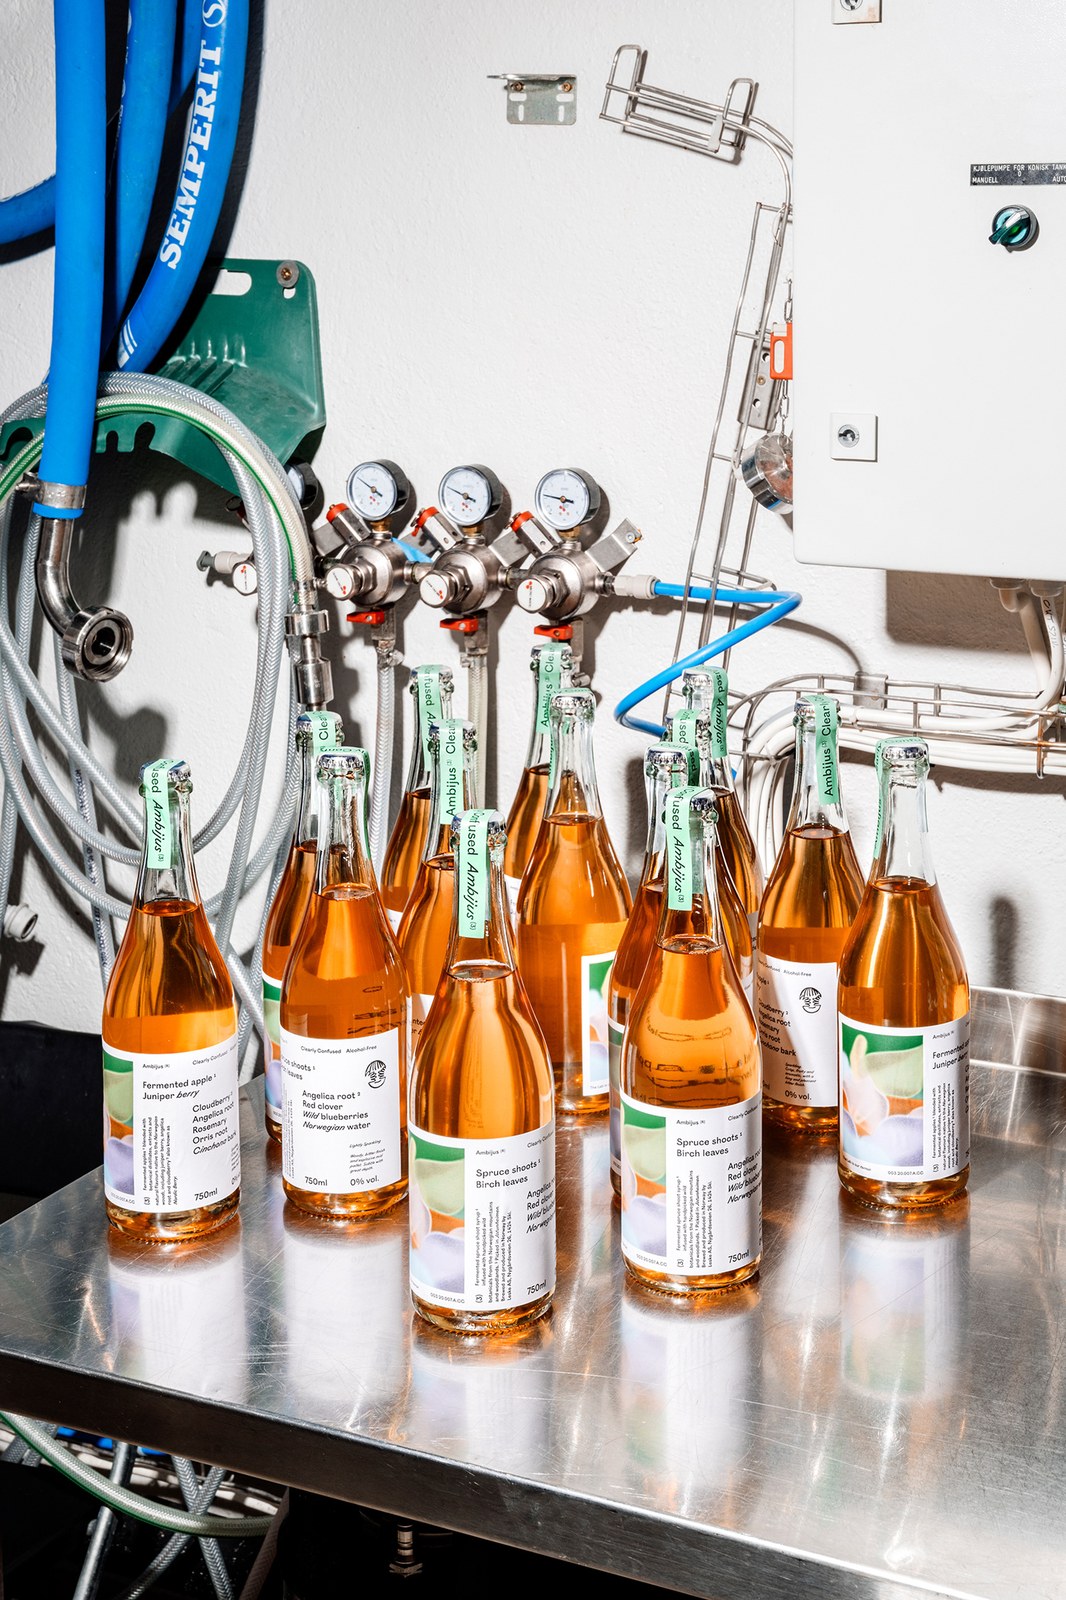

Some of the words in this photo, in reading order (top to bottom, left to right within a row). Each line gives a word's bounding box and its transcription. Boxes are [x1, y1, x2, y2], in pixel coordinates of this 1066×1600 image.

[159, 39, 222, 270] SEMPERIT
[973, 164, 1010, 172] KJØLEPUMPE
[1028, 164, 1049, 172] KONISK
[714, 698, 725, 744] Ambijus
[822, 748, 834, 796] Ambijus
[446, 767, 460, 816] Ambijus
[152, 800, 166, 852] Ambijus
[672, 836, 686, 894] Ambijus
[464, 862, 479, 920] Ambijus
[776, 1018, 791, 1027] root
[768, 1034, 781, 1043] root
[780, 1047, 796, 1056] bark
[291, 1061, 311, 1071] shoots
[932, 1058, 957, 1069] Juniper
[142, 1080, 188, 1089] Fermented
[191, 1075, 213, 1087] apple
[142, 1092, 174, 1102] Juniper
[176, 1090, 200, 1098] berry
[302, 1090, 335, 1100] Angelica
[192, 1095, 230, 1113] Cloudberry
[302, 1100, 315, 1109] Red
[192, 1110, 224, 1123] Angelica
[303, 1111, 320, 1119] Wild
[321, 1111, 369, 1120] blueberries
[192, 1118, 227, 1134] Rosemary
[303, 1121, 346, 1132] Norwegian
[347, 1122, 371, 1131] water
[192, 1133, 213, 1144] Orris
[215, 1127, 228, 1138] root
[677, 1138, 709, 1147] Spruce
[712, 1133, 738, 1145] shoots
[677, 1149, 700, 1157] Birch
[702, 1148, 728, 1157] leaves
[728, 1154, 754, 1170] Angelica
[476, 1169, 509, 1178] Spruce
[512, 1162, 537, 1174] shoots
[728, 1171, 741, 1181] Red
[304, 1176, 328, 1186] 750ml
[366, 1175, 379, 1184] vol.
[476, 1179, 500, 1188] Birch
[502, 1176, 528, 1186] leaves
[728, 1180, 745, 1192] Wild
[195, 1188, 218, 1201] 750ml
[527, 1200, 539, 1210] Red
[527, 1208, 542, 1221] Wild
[728, 1250, 750, 1263] 750ml
[527, 1280, 547, 1295] 750ml
